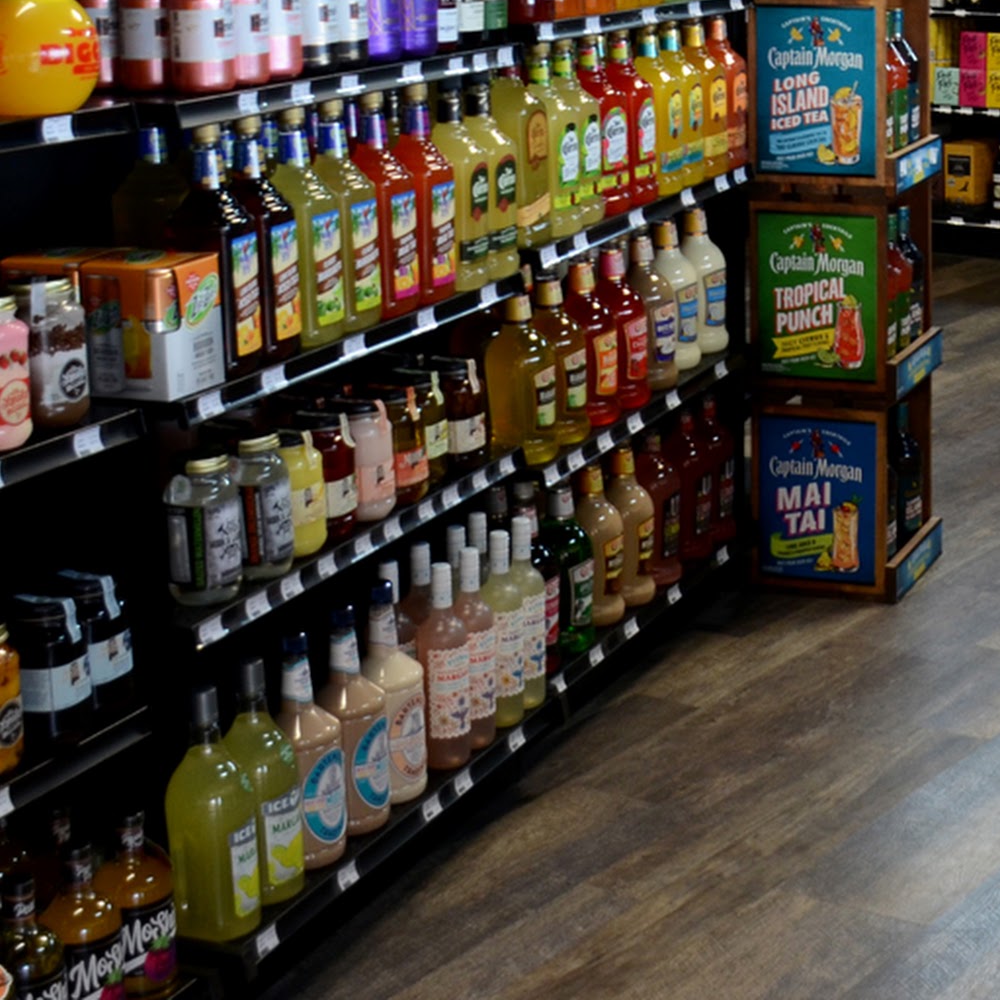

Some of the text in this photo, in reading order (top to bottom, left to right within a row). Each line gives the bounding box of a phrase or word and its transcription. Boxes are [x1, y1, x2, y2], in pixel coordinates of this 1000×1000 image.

[768, 46, 864, 71] Captain Morgan
[774, 71, 820, 92] LONG
[771, 86, 829, 116] ISLAND
[771, 109, 829, 131] ICED TEA
[769, 252, 865, 277] Captain Morgan
[773, 277, 847, 310] TROPICAL
[775, 303, 834, 334] PUNCH
[769, 456, 863, 483] Captain Morgan
[776, 482, 831, 513] MAI
[784, 509, 826, 536] TAI
